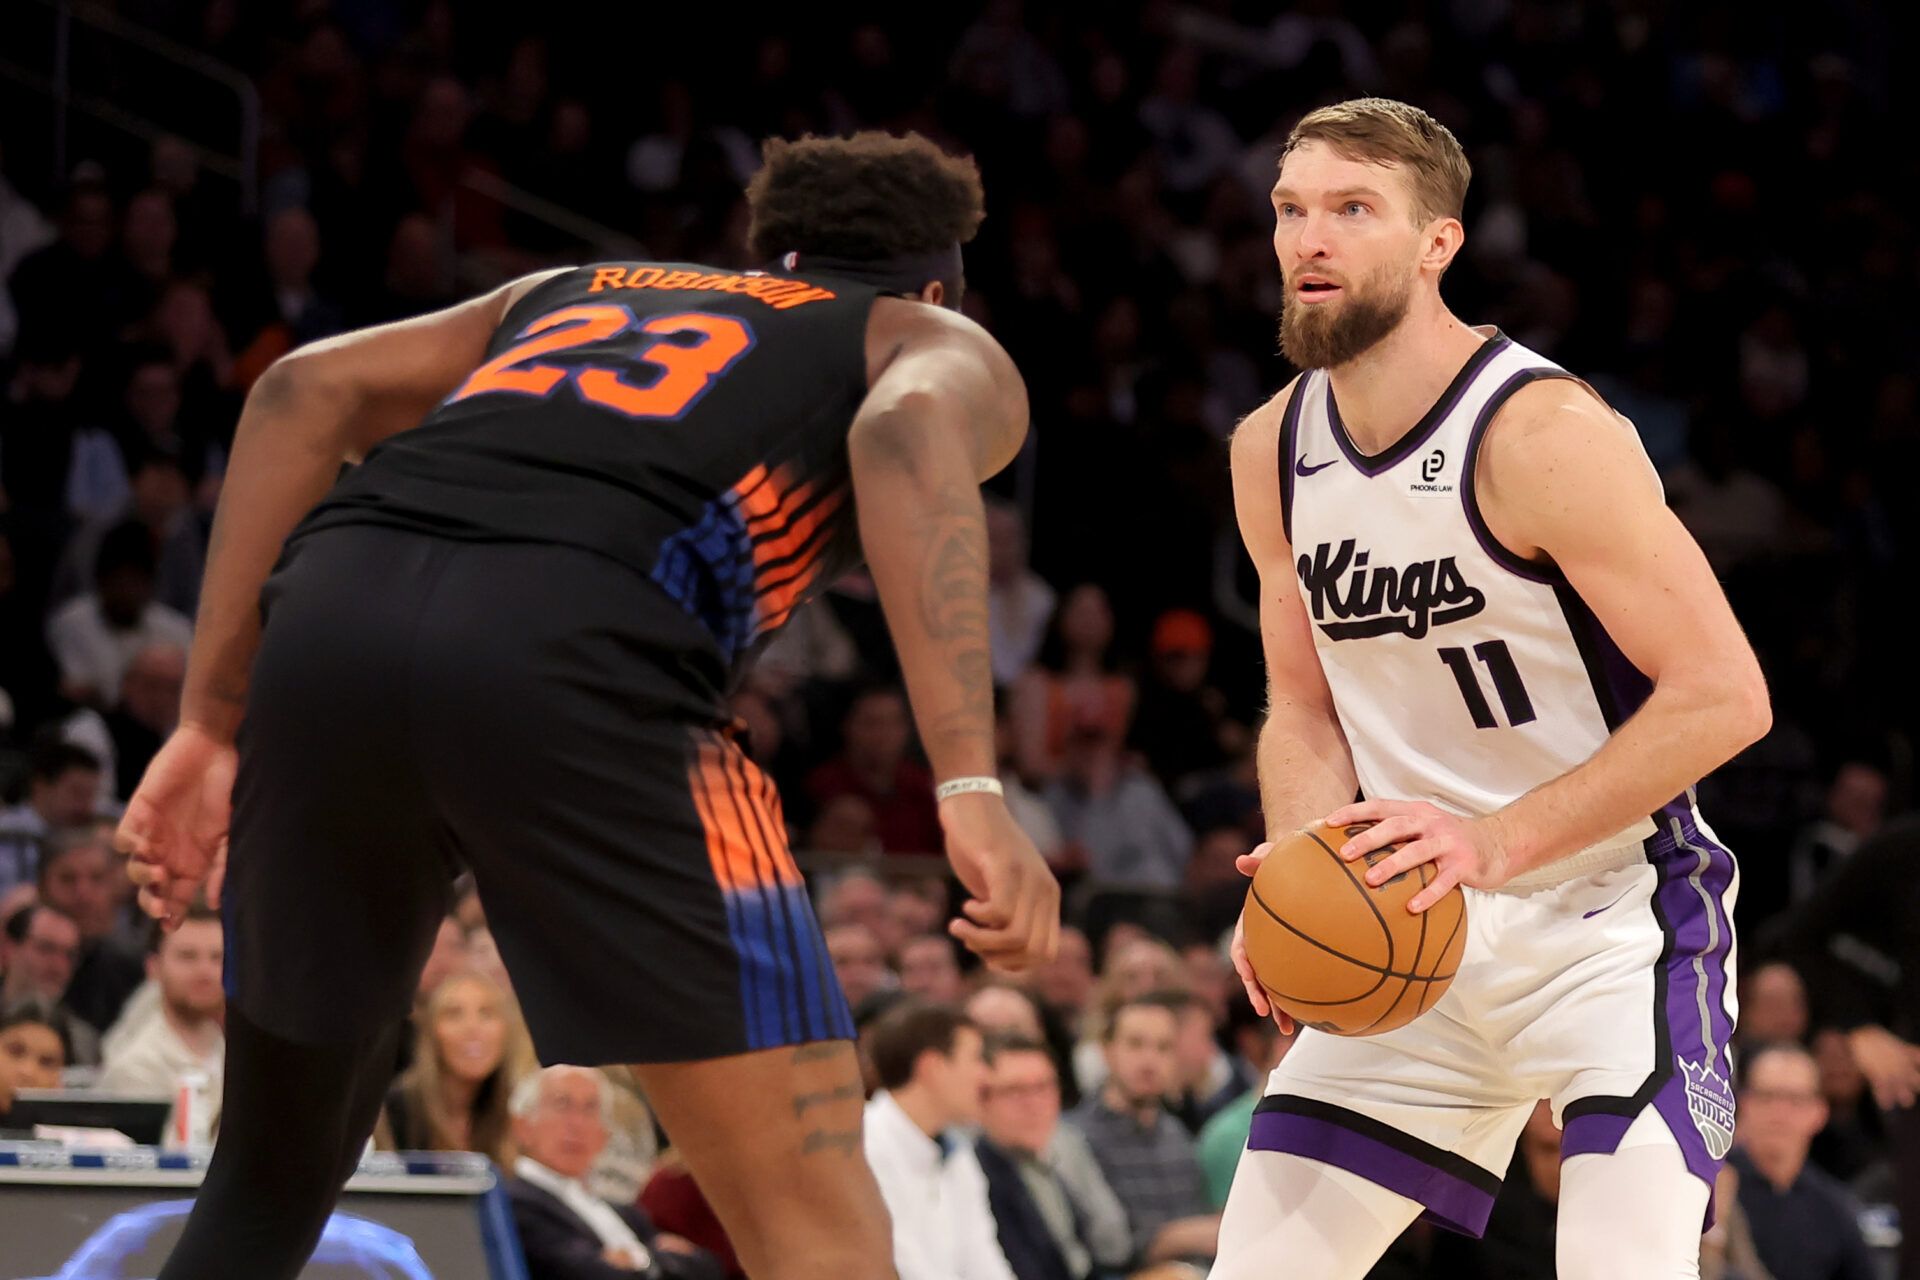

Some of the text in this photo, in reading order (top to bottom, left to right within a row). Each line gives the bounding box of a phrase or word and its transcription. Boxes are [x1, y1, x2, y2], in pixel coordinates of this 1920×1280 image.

[589, 267, 836, 309] ROBINSON
[445, 303, 757, 421] 23
[1410, 484, 1453, 492] PHOONG LAW
[1297, 538, 1486, 641] Kings
[1437, 639, 1537, 730] 11
[1690, 1082, 1734, 1111] SACRAMENTO
[1691, 1095, 1734, 1132] KINGS
